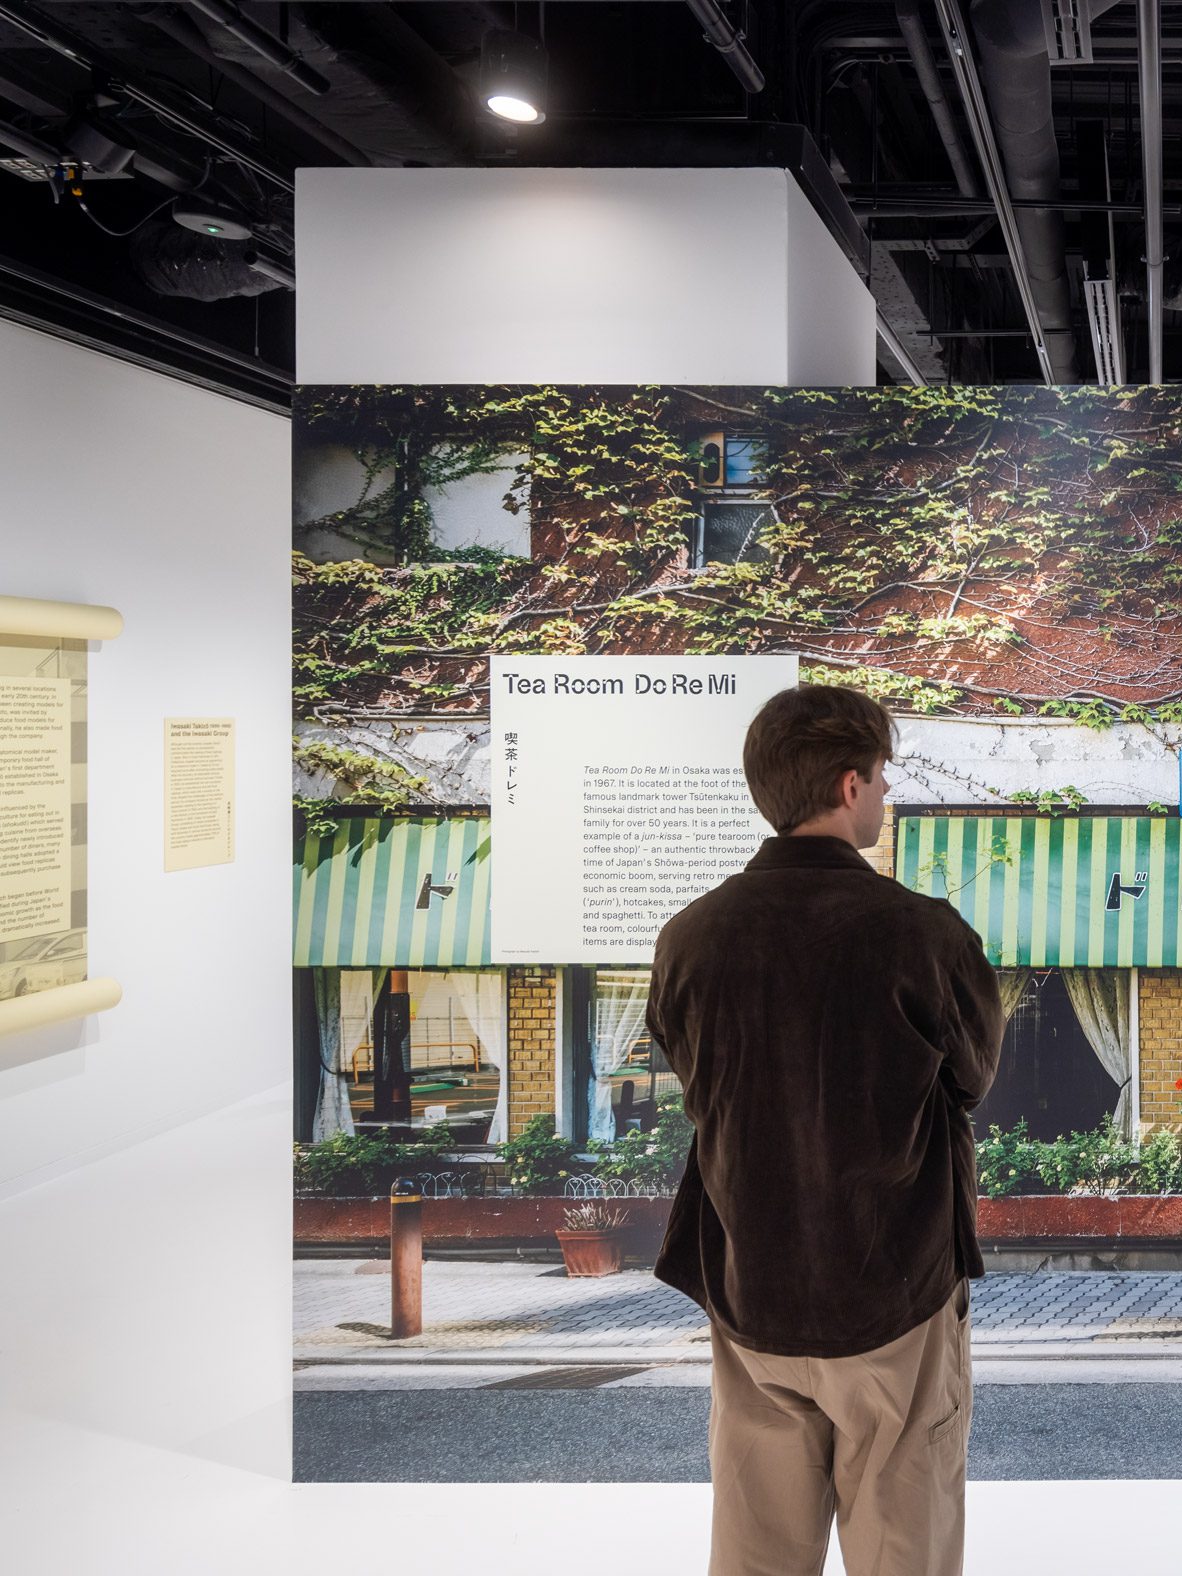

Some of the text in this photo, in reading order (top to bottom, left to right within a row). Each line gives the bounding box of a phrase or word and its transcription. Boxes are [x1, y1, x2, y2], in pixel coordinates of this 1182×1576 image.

[503, 674, 735, 694] Tea Room Do Re Mi
[504, 732, 518, 805] 喫茶ドレミ
[584, 766, 599, 774] Tea
[602, 766, 628, 774] Room
[631, 766, 642, 774] Do
[683, 766, 710, 774] Osaka
[594, 779, 616, 787] 1967.
[721, 779, 730, 787] of
[584, 805, 624, 814] Shinsekai
[697, 806, 718, 814] been
[584, 819, 610, 828] family
[649, 819, 660, 827] 50
[719, 819, 750, 829] perfect
[584, 832, 620, 841] example
[641, 833, 682, 841] jun-kissa
[606, 858, 614, 866] of
[719, 860, 747, 868] postw
[629, 872, 656, 880] boom,
[659, 872, 690, 881] serving
[416, 873, 458, 911] ド
[650, 885, 673, 894] soda,
[624, 898, 666, 907] hotcakes,
[602, 911, 645, 921] spaghetti.
